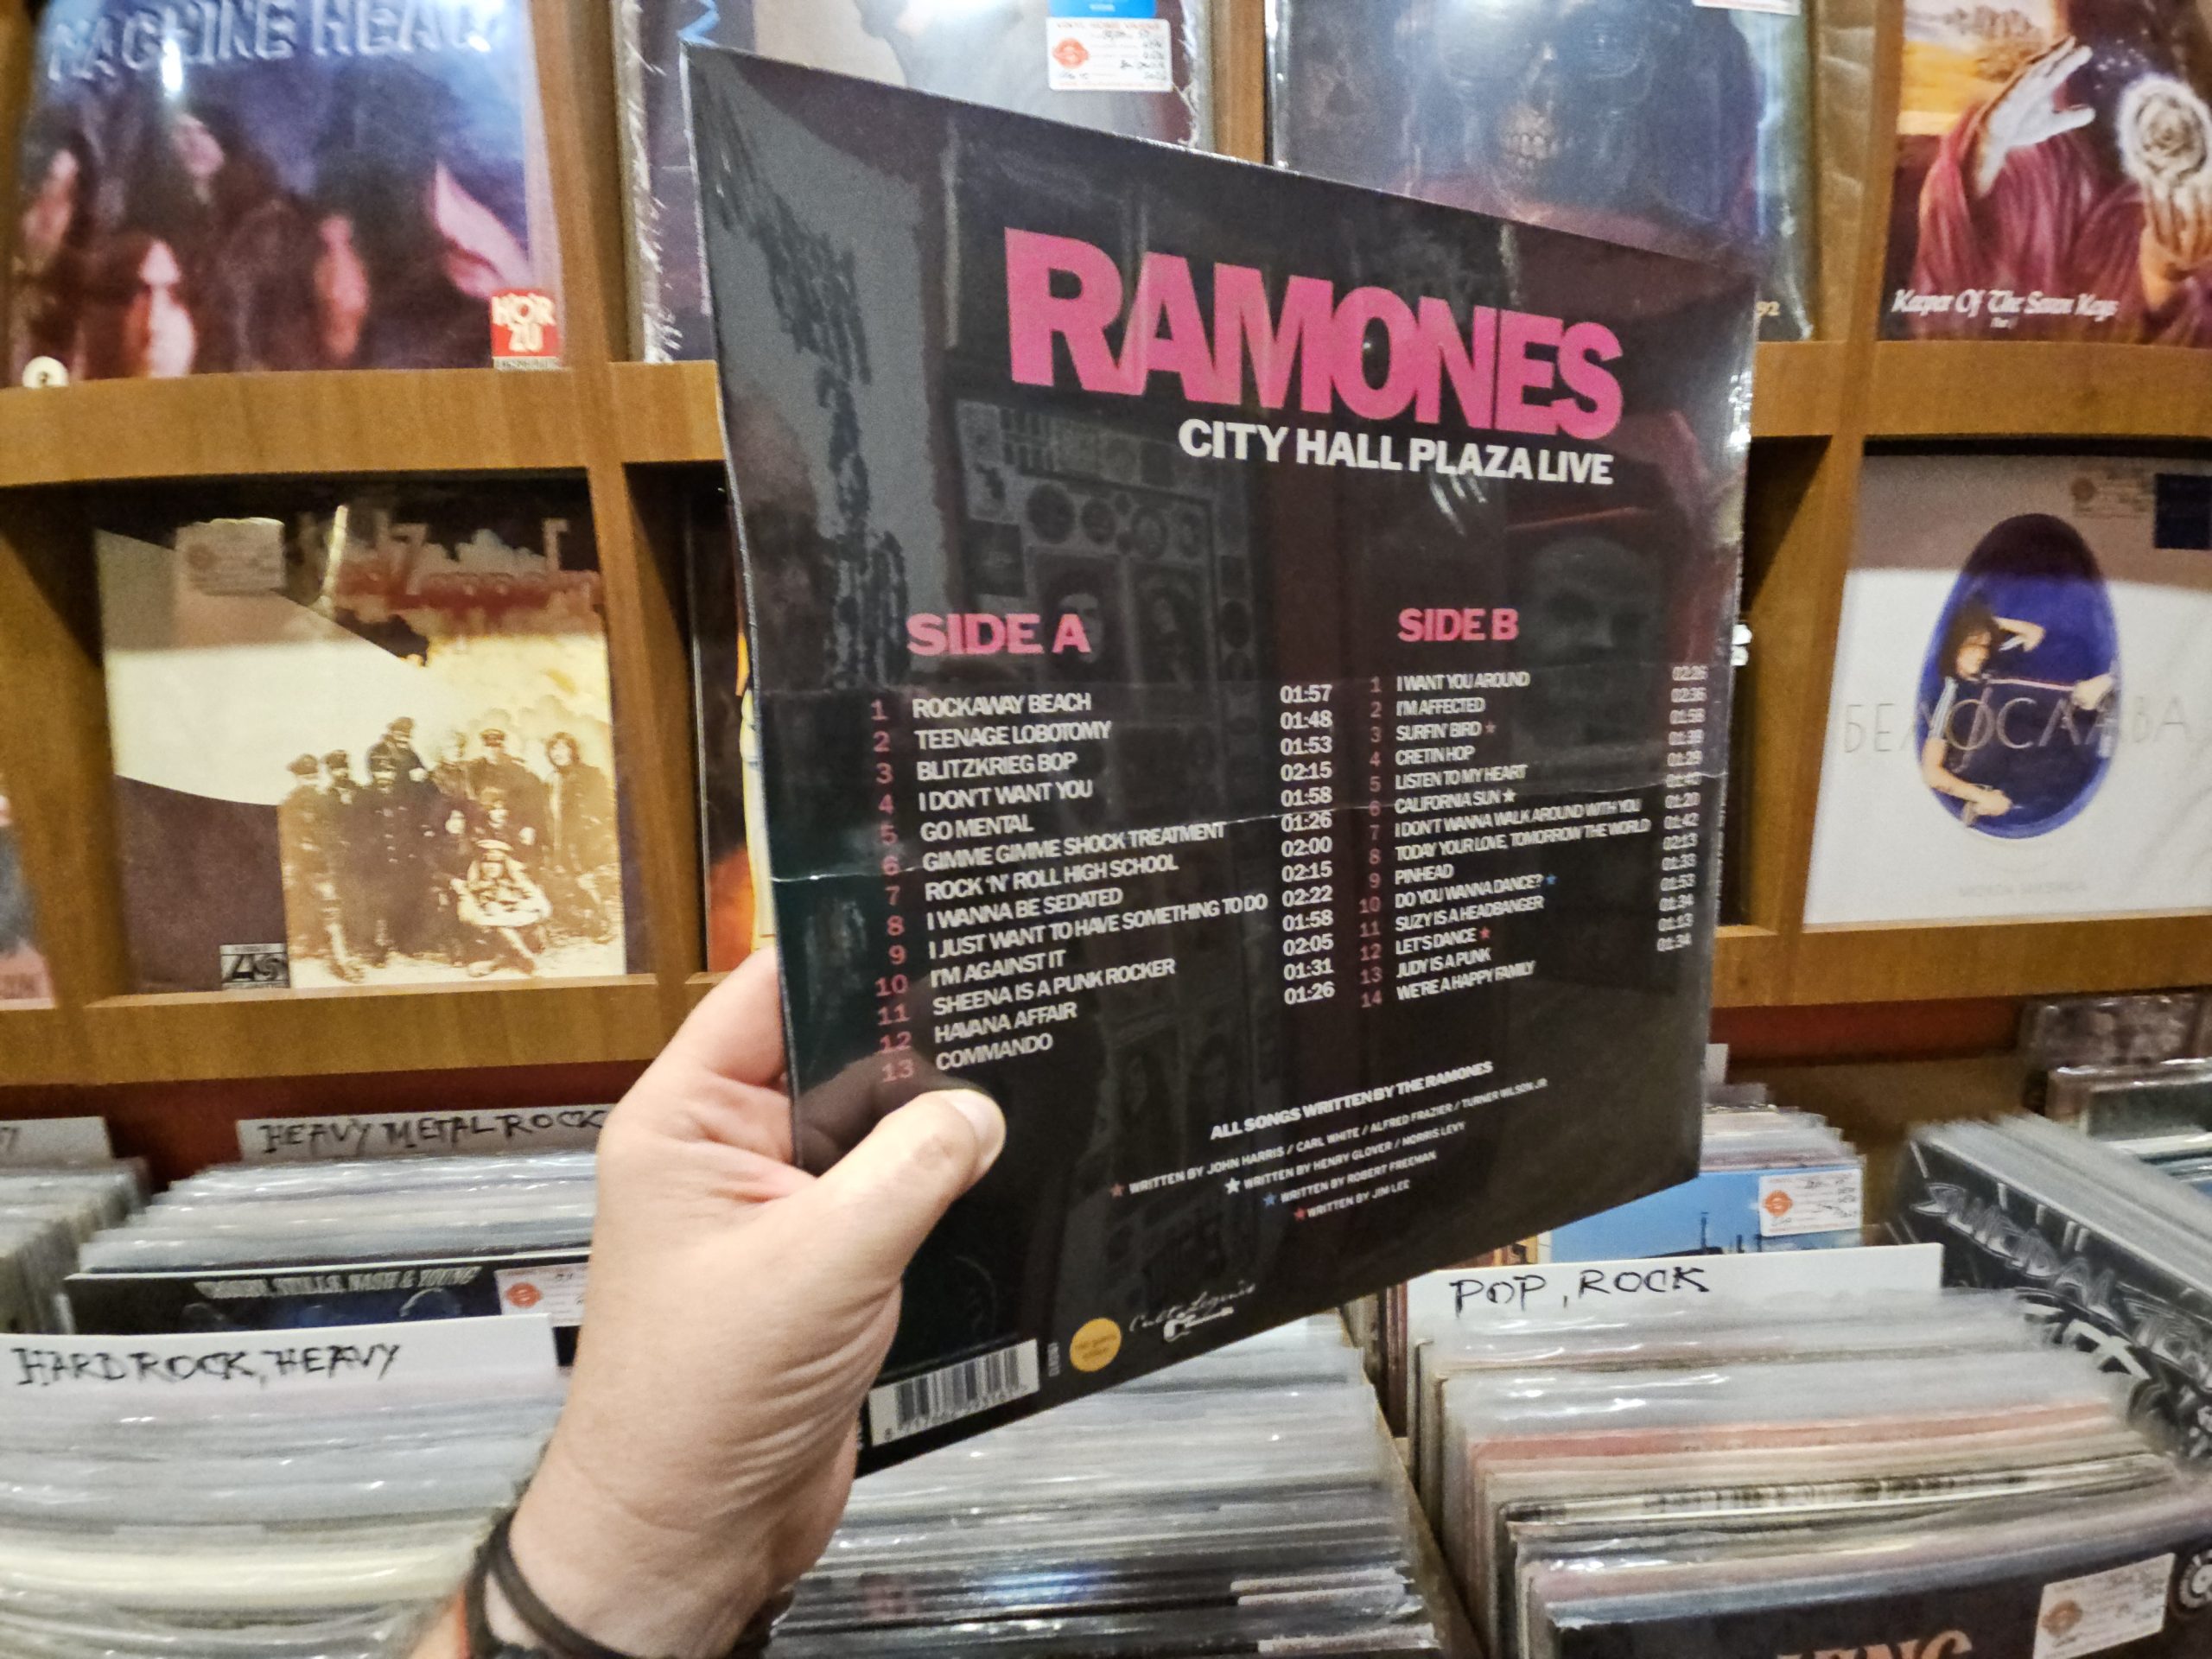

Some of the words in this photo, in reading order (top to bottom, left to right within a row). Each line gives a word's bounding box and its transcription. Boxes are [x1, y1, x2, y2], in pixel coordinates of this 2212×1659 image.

[1004, 227, 1624, 440] RAMONES
[1178, 418, 1289, 464] CITY
[1296, 429, 1402, 472] HALL
[1409, 437, 1533, 480] PLAZA
[1539, 448, 1614, 485] LIVE
[906, 613, 1044, 657] SIDE
[1052, 613, 1091, 654] A
[1397, 607, 1486, 642] SIDE
[1491, 607, 1520, 641] B
[870, 701, 887, 720] 1
[912, 695, 1026, 718] ROCKAWAY
[1028, 692, 1092, 714] BEACH
[1280, 684, 1333, 704] 01:57
[1396, 676, 1402, 691] I
[1403, 674, 1446, 691] WANT
[1446, 673, 1474, 690] YOU
[1474, 671, 1531, 688] AROUND
[1418, 696, 1487, 715] AFFECTED
[874, 731, 890, 752] 2
[913, 726, 1011, 749] TEENAGE
[1013, 721, 1112, 744] LOBOTOMY
[1281, 710, 1333, 730] 01:48
[876, 762, 893, 784] 3
[917, 754, 1035, 780] BLITZKRIEG
[1037, 751, 1078, 772] BOP
[1281, 736, 1333, 756] 01:53
[1395, 747, 1445, 766] CRETIN
[1446, 745, 1477, 761] HOP
[1395, 772, 1442, 790] LISTEN
[1443, 769, 1461, 785] TO
[1484, 763, 1529, 781] HEART
[878, 795, 894, 815] 4
[918, 791, 926, 811] I
[994, 782, 1052, 804] WANT
[1056, 779, 1094, 799] YOU
[1281, 762, 1333, 783] 02:15
[1395, 792, 1472, 814] CALIFORNIA
[1472, 789, 1502, 806] SUN
[919, 820, 953, 842] GO
[955, 814, 1035, 837] MENTAL
[1281, 786, 1333, 808] 01:58
[1395, 823, 1401, 837] I
[1443, 813, 1493, 831] WANNA
[1494, 809, 1532, 826] WALK
[1531, 804, 1585, 822] AROUND
[1618, 798, 1643, 813] YOU
[922, 846, 994, 871] GIMME
[995, 839, 1062, 863] GIMME
[1065, 832, 1127, 855] SHOCK
[1128, 821, 1226, 847] TREATMENT
[1281, 811, 1333, 833] 01:26
[1395, 842, 1436, 861] TODAY
[1439, 837, 1474, 855] YOUR
[1509, 825, 1584, 847] TOMORROW
[1584, 823, 1608, 838] THE
[1608, 817, 1651, 836] WORLD
[885, 886, 900, 906] 7
[925, 877, 984, 900] ROCK
[1014, 868, 1062, 890] ROLL
[1065, 861, 1108, 883] HIGH
[1110, 854, 1179, 878] SCHOOL
[1281, 836, 1333, 858] 02:00
[1395, 863, 1455, 885] PINHEAD
[1395, 892, 1417, 909] DO
[1417, 887, 1443, 905] YOU
[1445, 880, 1494, 900] WANNA
[1494, 874, 1544, 893] DANCE?
[887, 915, 904, 936] 8
[926, 912, 935, 931] I
[937, 903, 1014, 928] WANNA
[1016, 897, 1041, 918] BE
[1044, 887, 1123, 914] SEDATED
[1281, 861, 1333, 883] 02:15
[1395, 912, 1433, 931] SUZY
[1433, 909, 1447, 925] IS
[1447, 907, 1460, 923] A
[1460, 894, 1545, 920] HEADBANGER
[889, 944, 906, 964] 9
[928, 940, 937, 959] I
[939, 933, 985, 958] JUST
[989, 925, 1046, 950] WANT
[1048, 921, 1074, 941] TO
[1076, 913, 1121, 937] HAVE
[1122, 899, 1220, 929] SOMETHING
[1222, 896, 1243, 914] TO
[1244, 893, 1268, 912] DO
[1282, 886, 1333, 908] 02:22
[1433, 927, 1478, 948] DANCE
[876, 975, 908, 997] 10
[963, 952, 1046, 982] AGAINST
[1048, 949, 1067, 968] IT
[1282, 910, 1334, 932] 01:58
[1396, 958, 1429, 978] JUDY
[1430, 955, 1445, 971] IS
[1445, 954, 1456, 969] A
[1456, 947, 1492, 966] PUNK
[878, 1004, 910, 1027] 11
[932, 986, 1014, 1015] SHEENA
[1015, 982, 1034, 1001] IS
[1036, 979, 1052, 997] A
[1053, 969, 1103, 995] PUNK
[1105, 957, 1176, 984] ROCKER
[1283, 934, 1335, 957] 02:05
[1440, 976, 1452, 992] A
[1452, 969, 1493, 989] HAPPY
[880, 1032, 912, 1053] 12
[934, 1014, 1012, 1043] HAVANA
[1014, 1001, 1078, 1028] AFFAIR
[1284, 958, 1335, 982] 01:31
[882, 1060, 914, 1083] 13
[936, 1033, 1053, 1070] COMMANDO
[1284, 982, 1336, 1006] 01:26
[1210, 1121, 1243, 1140] ALL
[1244, 1107, 1301, 1132] SONGS
[1302, 1090, 1374, 1117] WRITTEN
[1373, 1084, 1394, 1102] BY
[1395, 1077, 1426, 1095] THE
[1426, 1061, 1493, 1088] RAMONES
[262, 1117, 369, 1157] HEAVY
[383, 1116, 494, 1149] METAL
[495, 1109, 607, 1138] ROCK
[1579, 1267, 1710, 1300] ROCK
[10, 1346, 126, 1386] HARD
[262, 1344, 401, 1381] HEAVY
